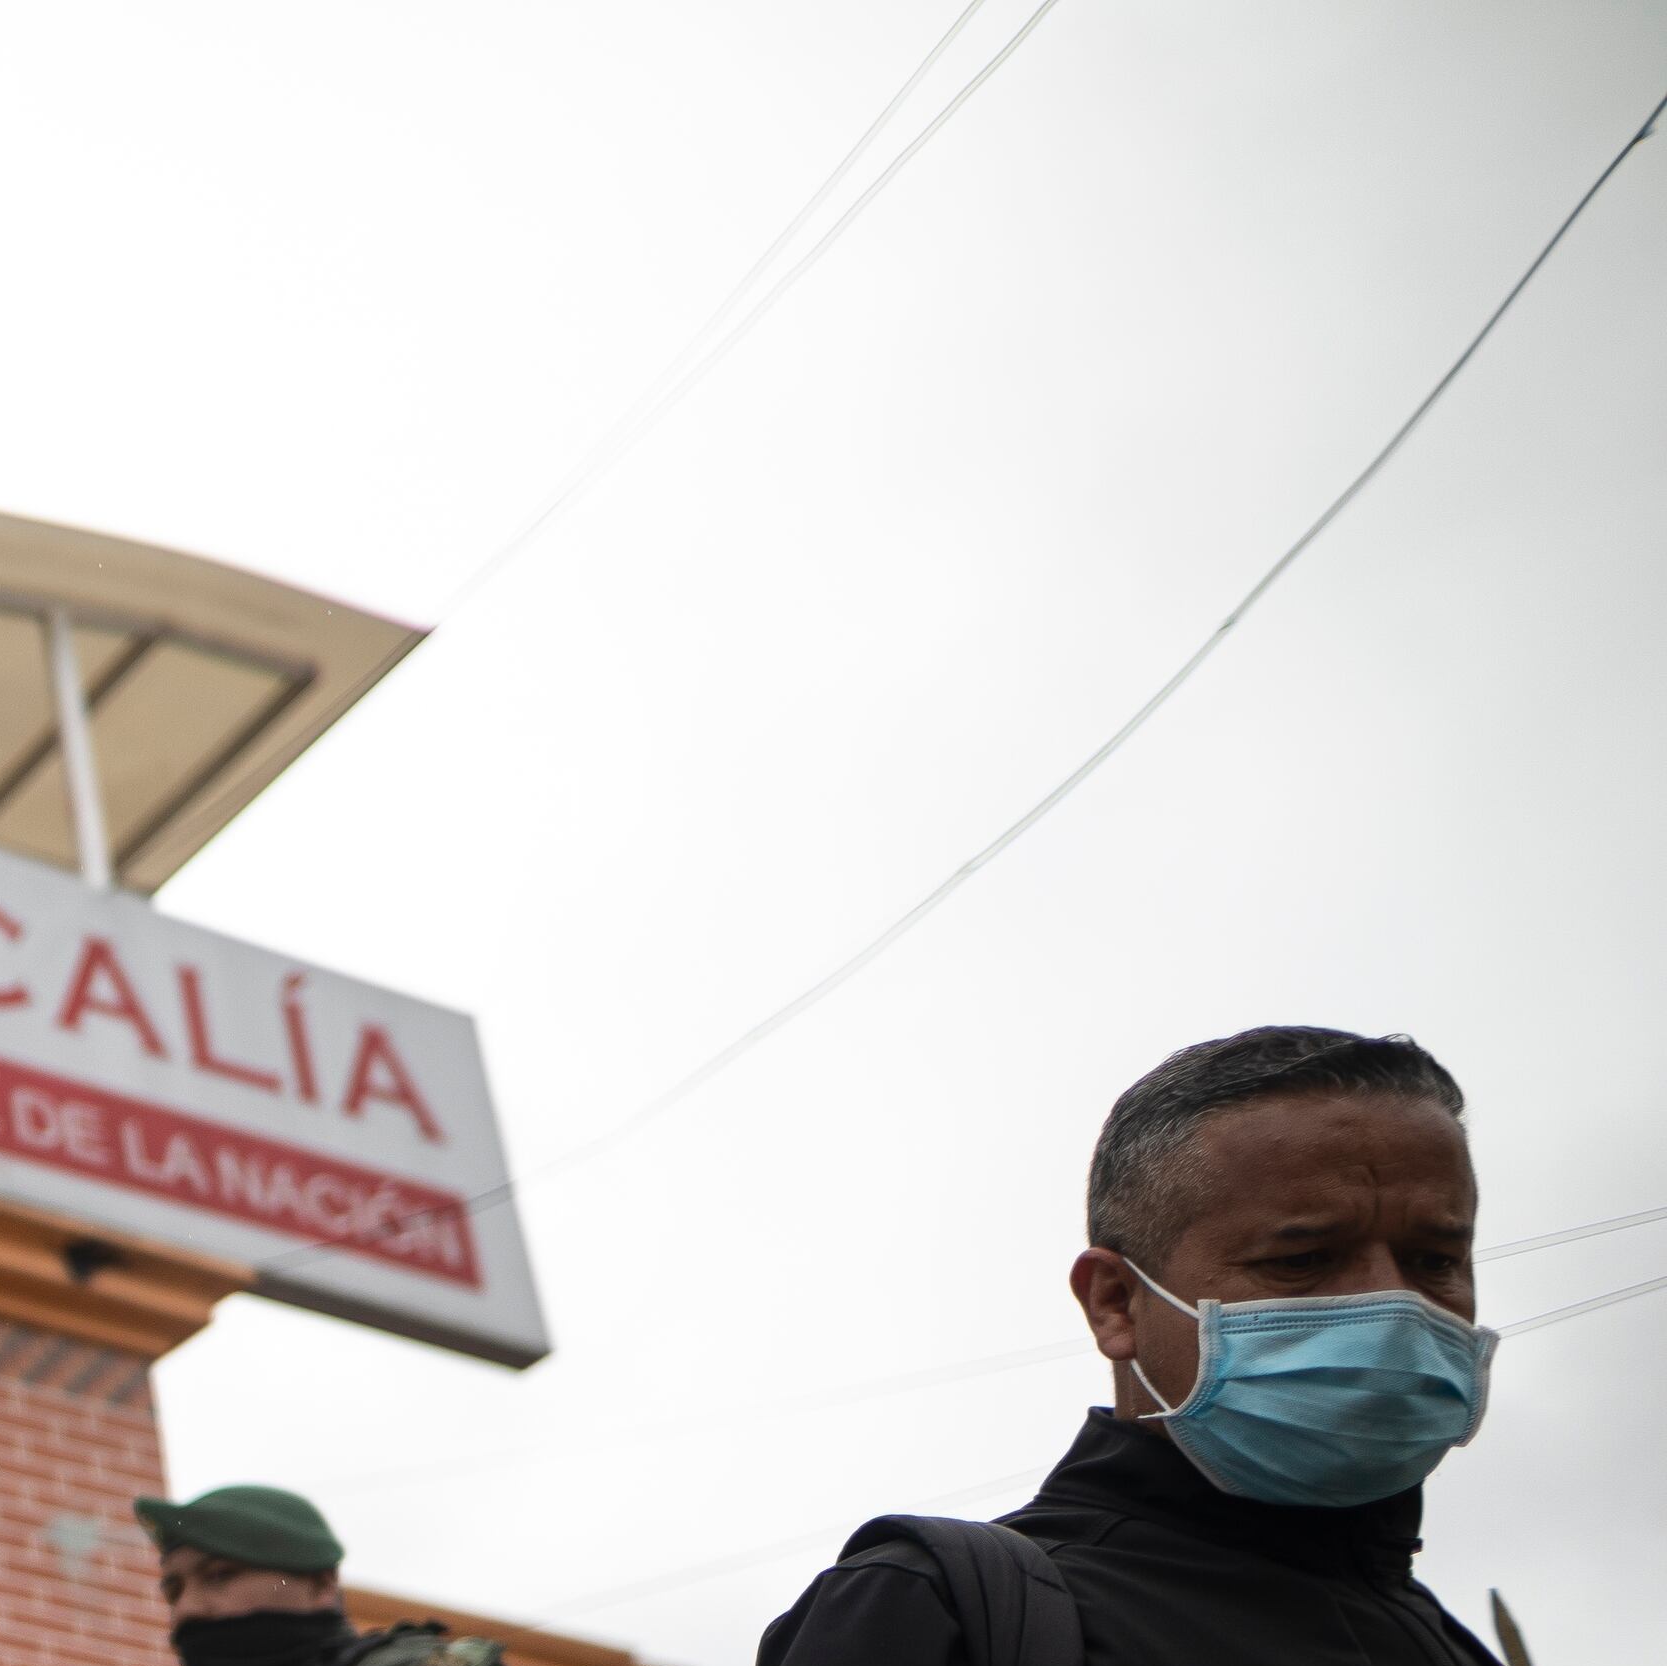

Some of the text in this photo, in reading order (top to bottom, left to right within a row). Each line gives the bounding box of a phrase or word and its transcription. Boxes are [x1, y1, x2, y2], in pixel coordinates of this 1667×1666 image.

[9, 1085, 109, 1168] DE
[119, 1119, 212, 1197] LA
[213, 1146, 466, 1268] NACIÓN
